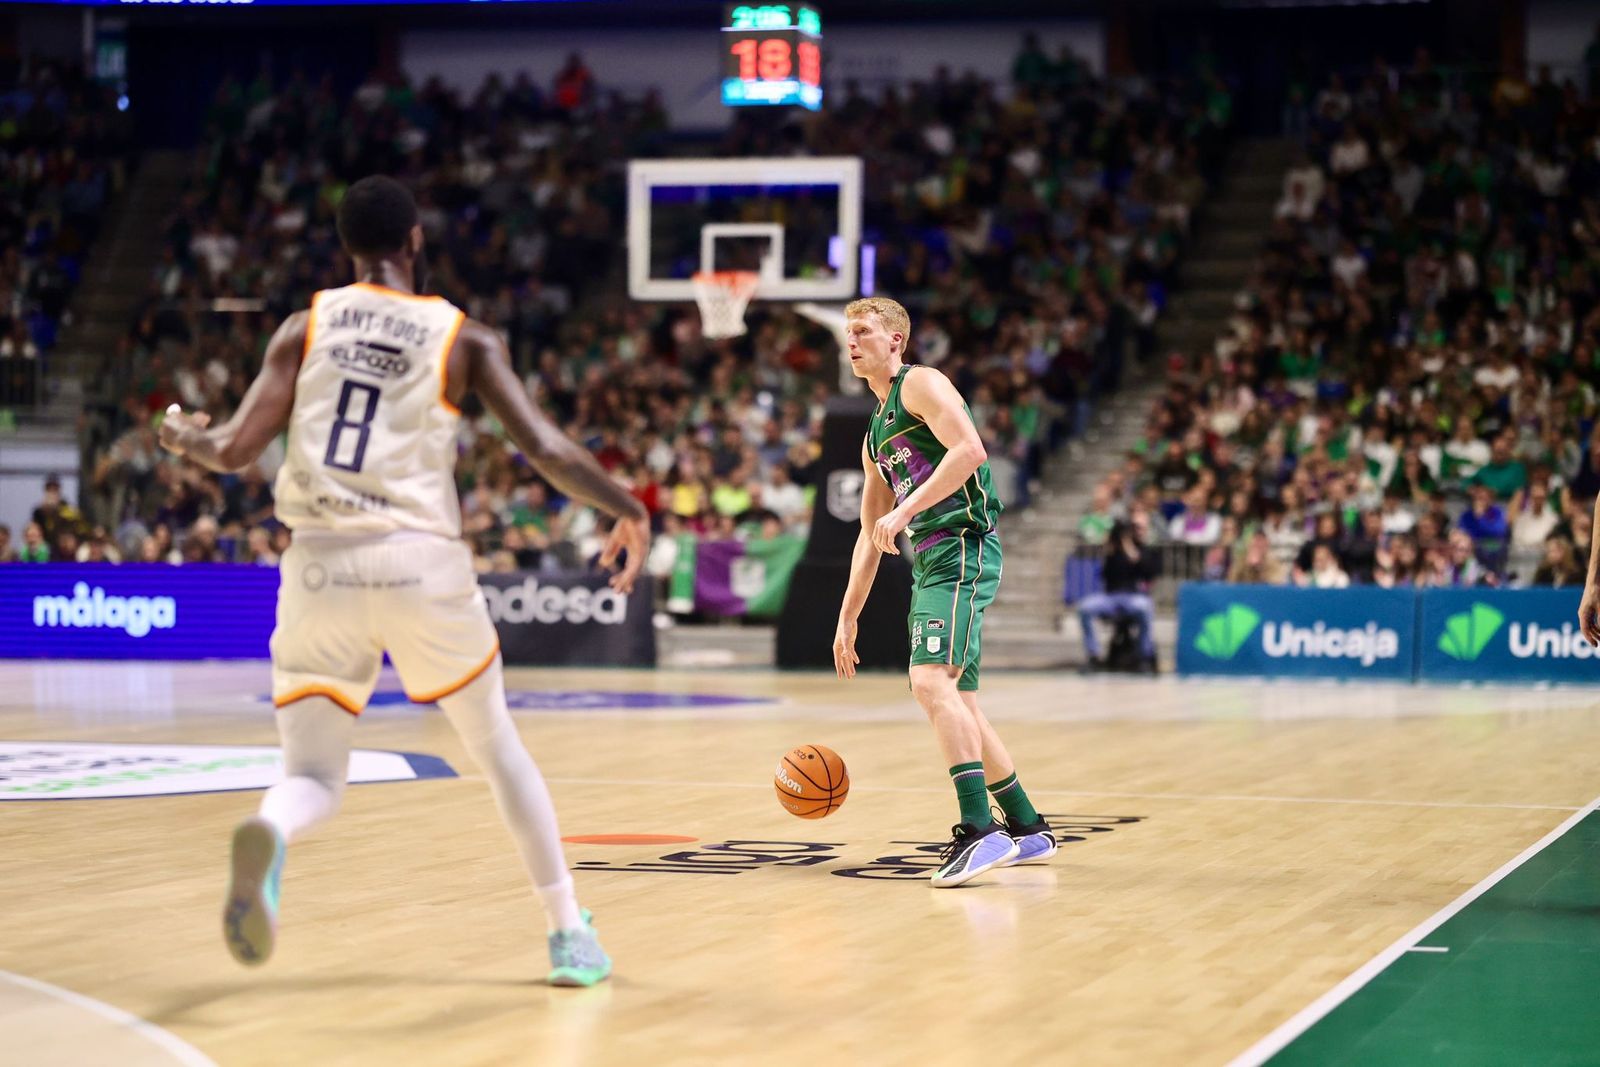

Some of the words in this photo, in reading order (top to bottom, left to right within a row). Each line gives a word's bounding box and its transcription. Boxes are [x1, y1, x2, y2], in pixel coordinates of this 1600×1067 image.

[730, 39, 792, 81] 18
[324, 379, 381, 473] 8
[33, 581, 176, 638] málaga
[480, 575, 628, 625] ndesa
[1262, 620, 1399, 667] Unicaja
